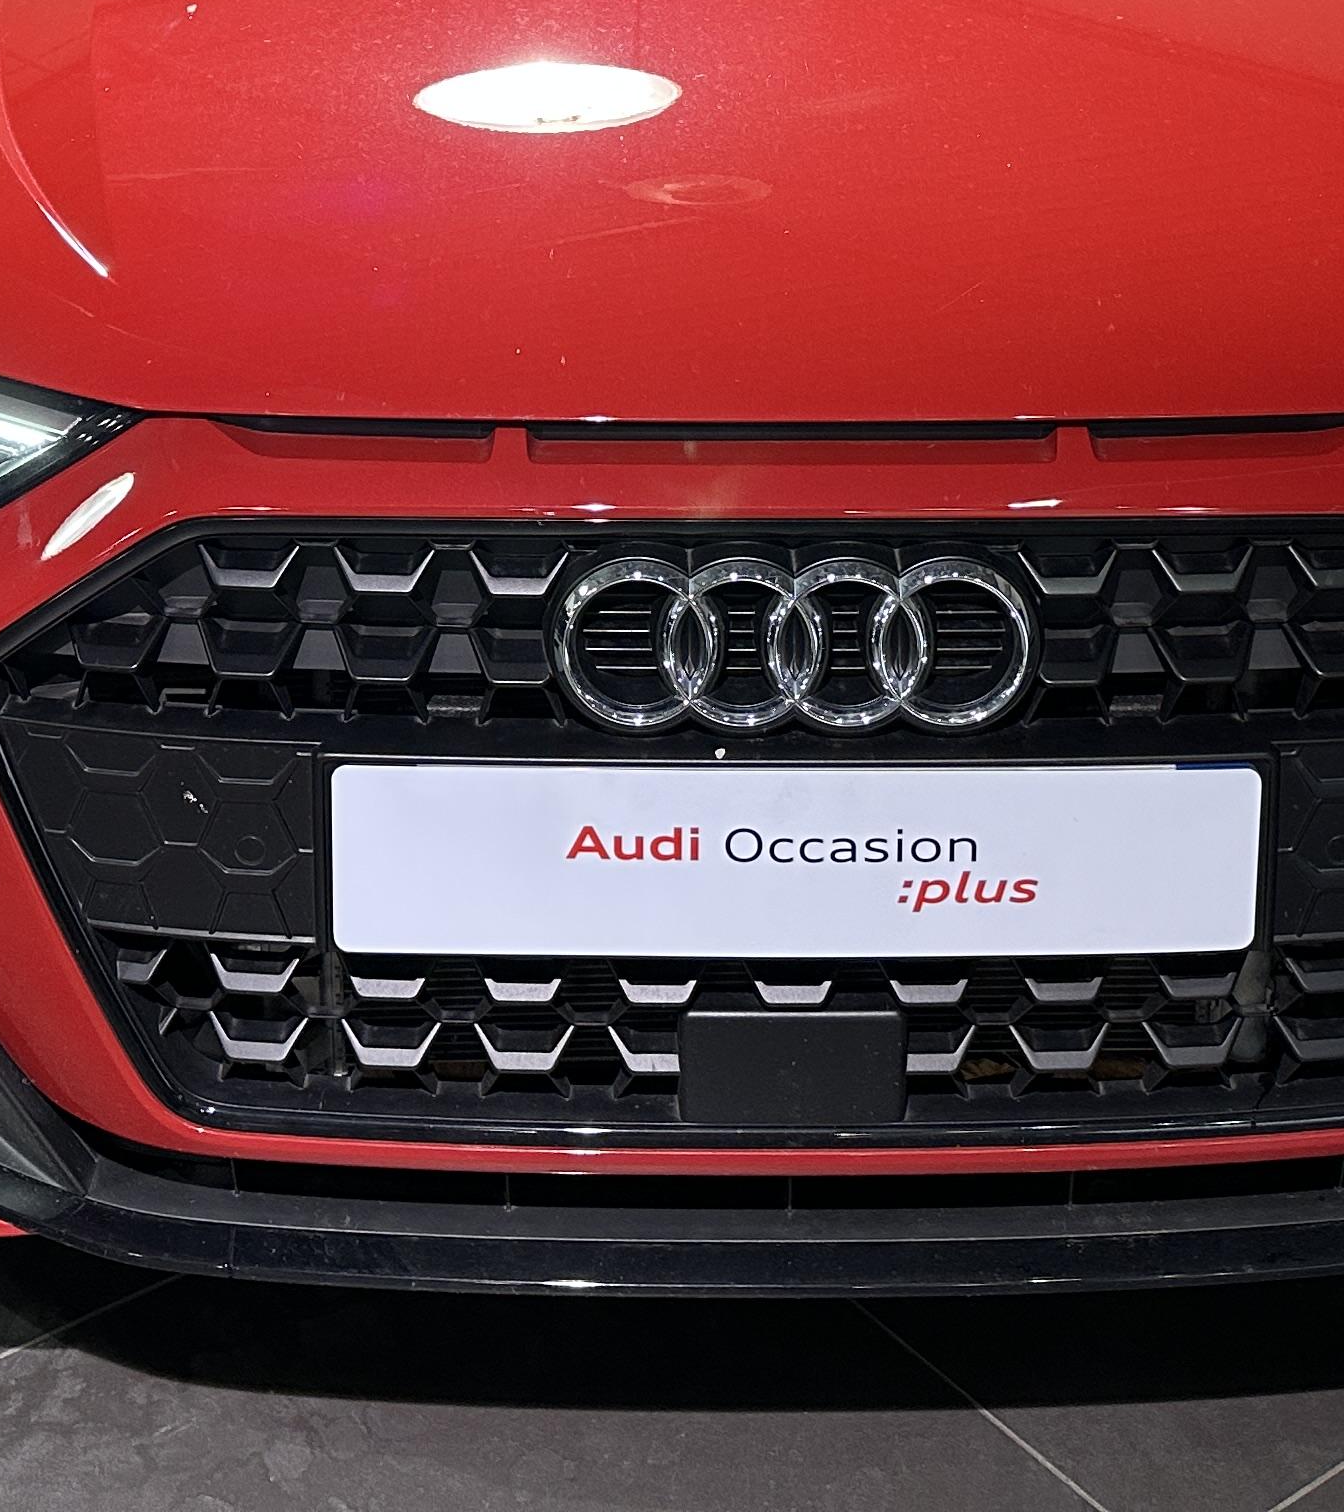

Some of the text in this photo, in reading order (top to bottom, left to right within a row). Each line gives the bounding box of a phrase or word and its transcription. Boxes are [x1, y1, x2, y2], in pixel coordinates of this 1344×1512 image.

[566, 824, 979, 864] Audi Occasion
[896, 870, 1039, 913] :plus
